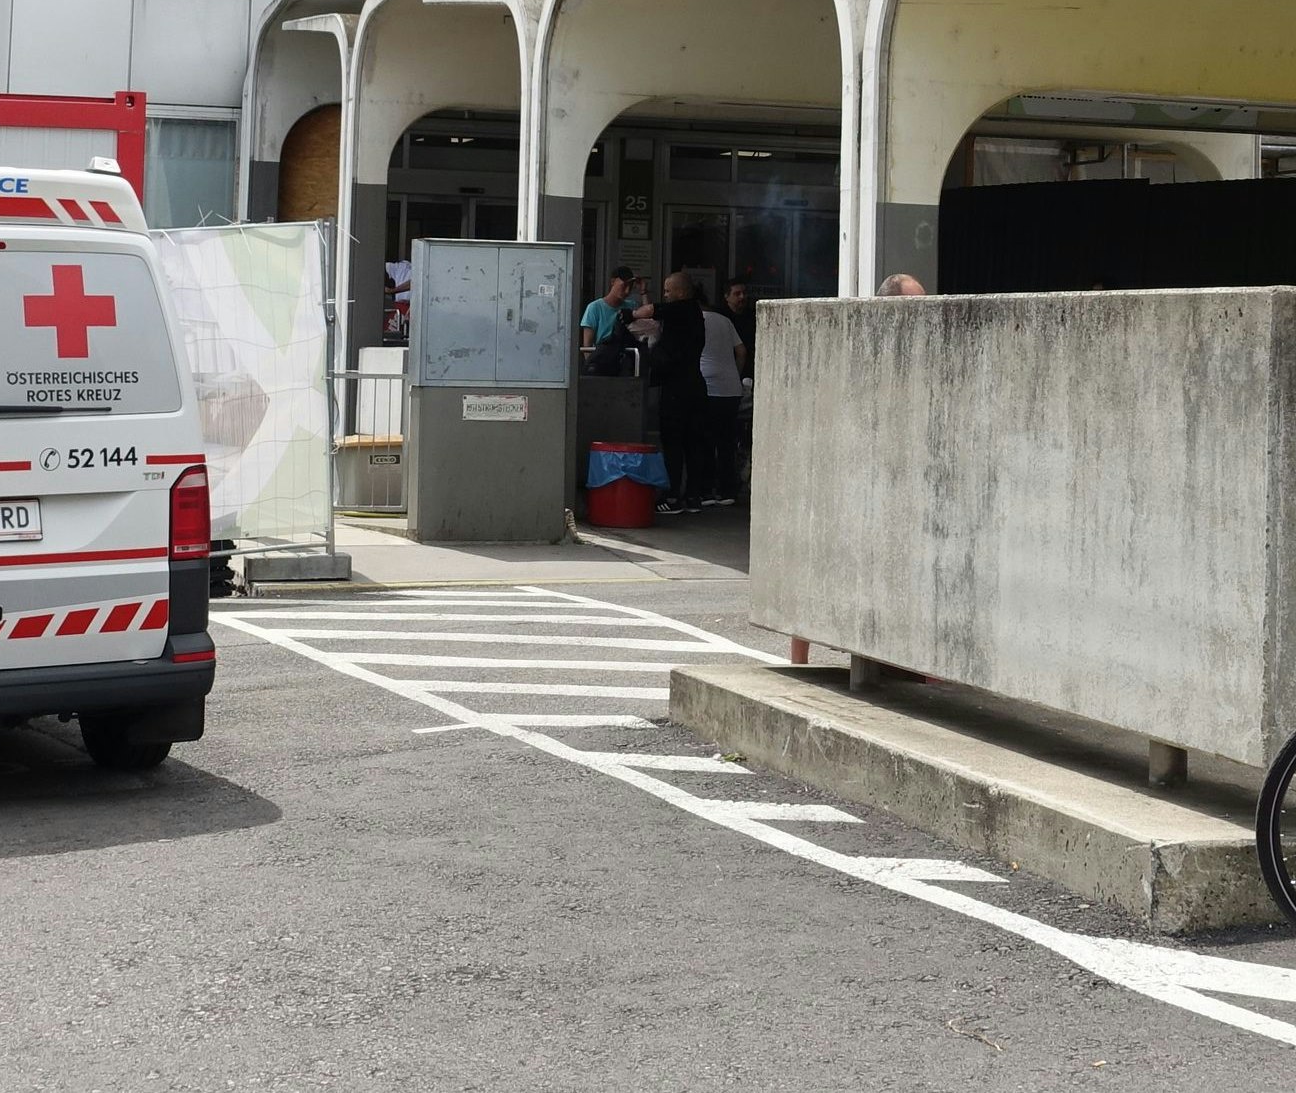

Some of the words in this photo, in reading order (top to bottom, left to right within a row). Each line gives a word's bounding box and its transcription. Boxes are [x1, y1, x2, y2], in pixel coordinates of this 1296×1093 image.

[625, 196, 647, 211] 25
[7, 371, 139, 385] ÖSTERREICHISCHES
[27, 389, 72, 402] ROTES
[77, 389, 122, 401] KREUZ
[67, 448, 94, 469] 52
[100, 447, 138, 467] 144
[143, 471, 165, 481] TDI
